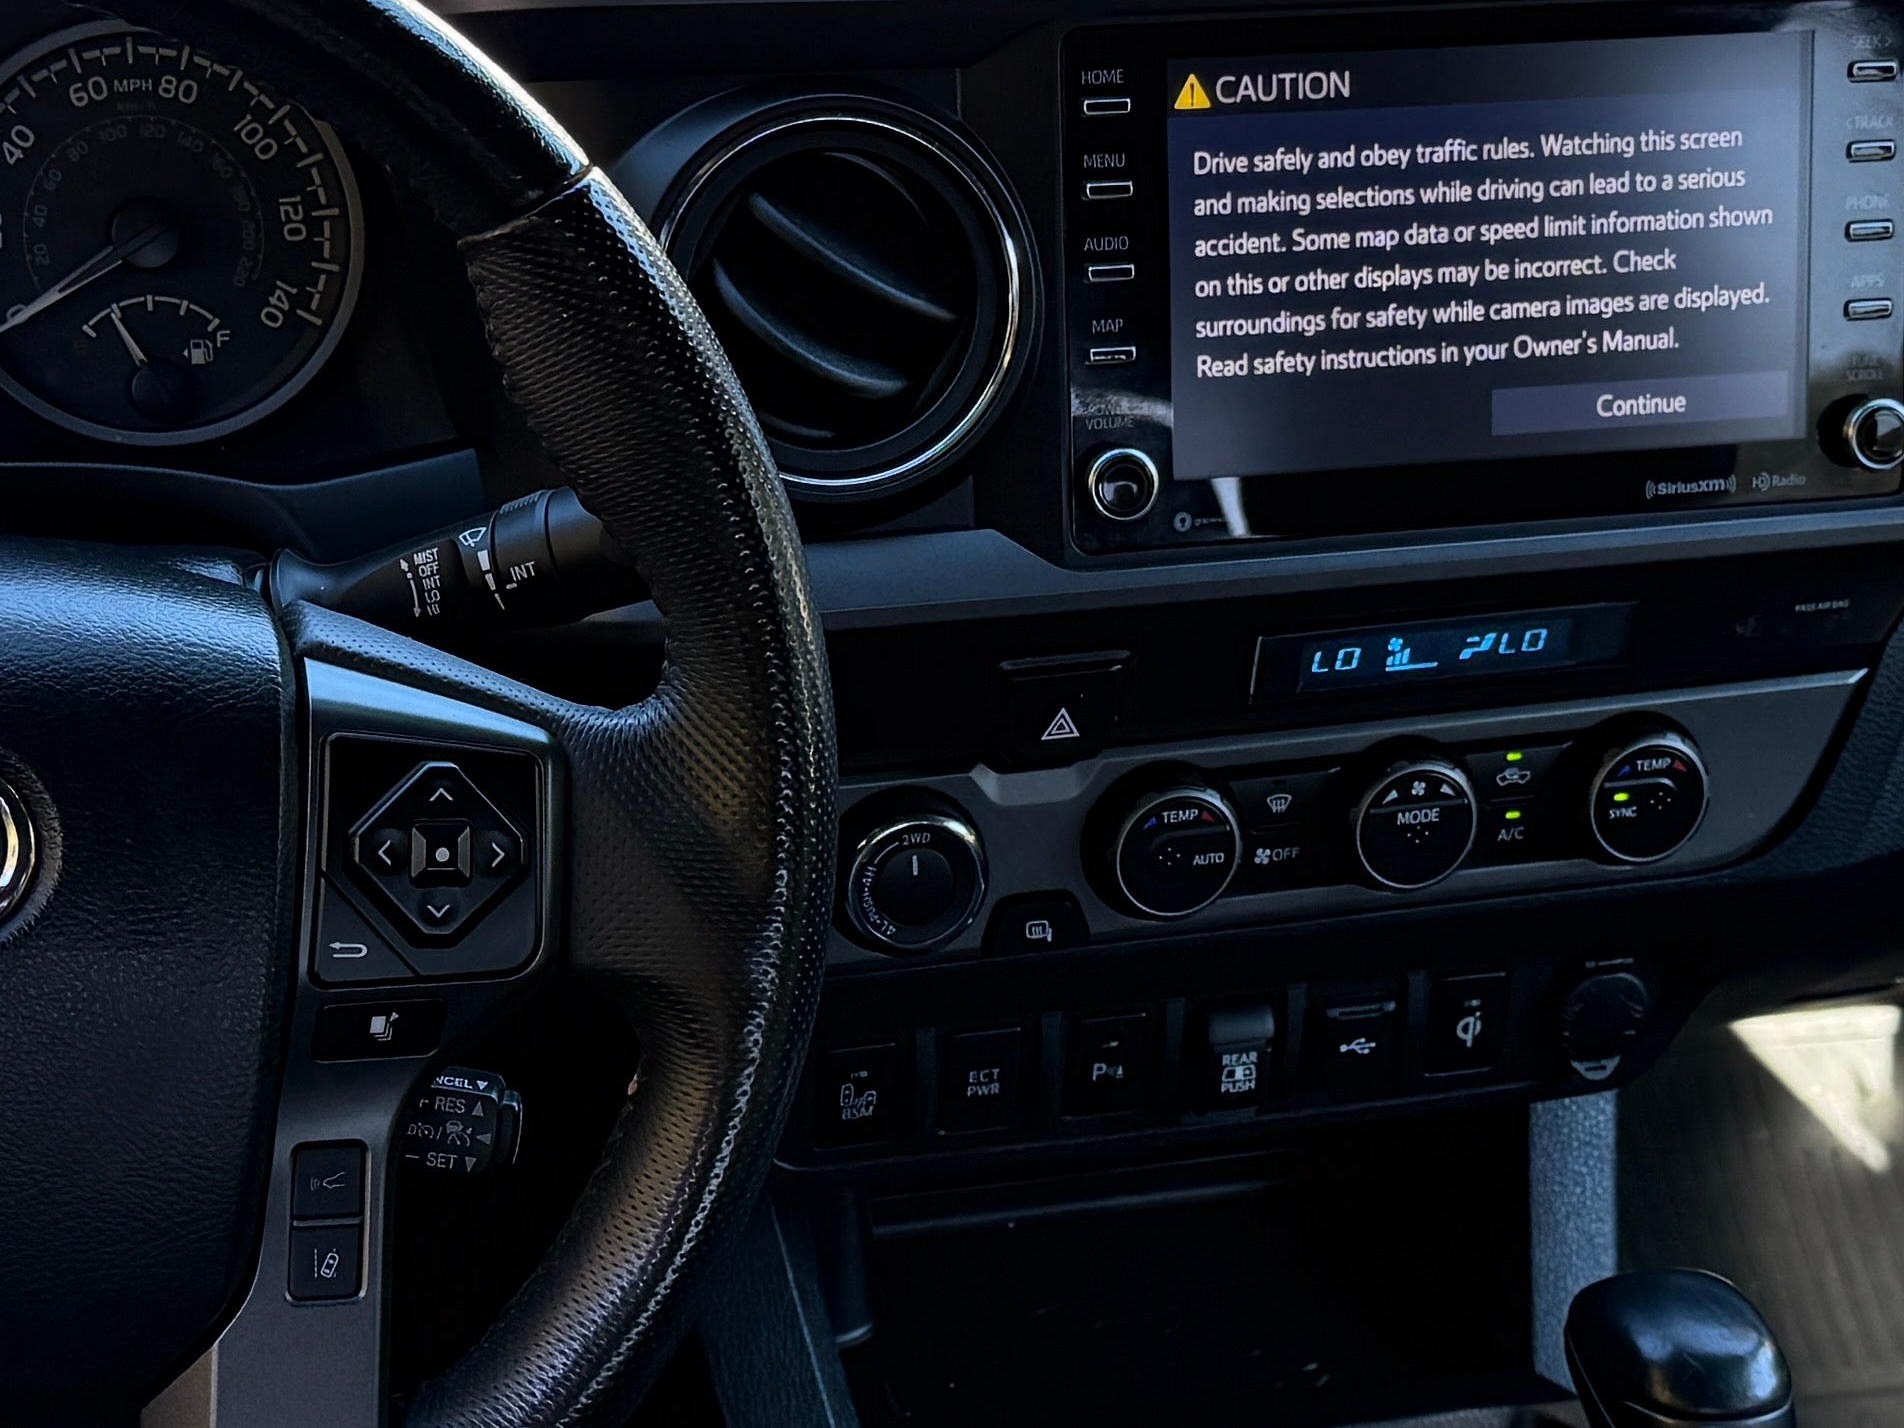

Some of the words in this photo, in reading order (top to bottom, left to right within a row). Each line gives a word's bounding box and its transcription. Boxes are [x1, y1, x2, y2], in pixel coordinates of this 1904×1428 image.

[1081, 69, 1125, 85] HOME
[68, 76, 109, 108] 60
[114, 79, 152, 93] MPH
[157, 75, 198, 104] 80
[1215, 71, 1350, 103] CAUTION
[1, 123, 35, 166] 40
[232, 114, 278, 161] 100
[1083, 152, 1125, 169] MENU
[1194, 152, 1248, 175] Drive
[1254, 147, 1313, 175] safely
[1318, 145, 1355, 168] and
[1361, 143, 1411, 170] obey
[1416, 139, 1478, 164] traffic
[1482, 137, 1535, 160] rules.
[1540, 132, 1634, 157] Watching
[1640, 129, 1675, 152] this
[1680, 129, 1742, 150] screen
[1194, 192, 1231, 216] and
[1238, 190, 1310, 215] making
[1316, 186, 1415, 210] selections
[1420, 180, 1472, 204] while
[1477, 179, 1544, 203] driving
[1549, 179, 1584, 197] can
[1590, 171, 1630, 195] lead
[1636, 173, 1656, 192] to
[1661, 174, 1673, 191] a
[1678, 168, 1745, 190] serious
[278, 196, 308, 242] 120
[1195, 233, 1286, 257] accident.
[1292, 228, 1350, 252] Some
[1356, 228, 1399, 251] map
[1404, 223, 1448, 246] data
[1454, 224, 1476, 242] or
[1480, 216, 1539, 245] speed
[1544, 215, 1586, 237] limit
[1591, 209, 1704, 234] information
[1709, 205, 1772, 228] shown
[1084, 236, 1129, 252] AUDIO
[1195, 279, 1222, 298] on
[1227, 273, 1263, 296] this
[1268, 276, 1289, 294] or
[1295, 268, 1348, 292] other
[1354, 264, 1433, 291] displays
[1438, 263, 1480, 286] may
[1485, 259, 1510, 281] be
[1515, 257, 1607, 279] incorrect.
[1613, 248, 1676, 273] Check
[260, 280, 298, 330] 140
[1196, 311, 1325, 338] surroundings
[1331, 307, 1361, 330] for
[1366, 304, 1427, 329] safety
[1433, 300, 1485, 324] while
[1489, 299, 1561, 321] camera
[1566, 294, 1634, 318] images
[1639, 292, 1669, 312] are
[1674, 282, 1769, 312] displayed.
[1092, 318, 1124, 334] MAP
[1197, 354, 1248, 378] Read
[1253, 350, 1315, 376] safety
[1321, 344, 1436, 371] instructions
[1441, 342, 1458, 364] in
[1464, 342, 1508, 367] your
[1513, 330, 1597, 359] Owner's
[1603, 327, 1679, 352] Manual.
[1597, 394, 1686, 417] Continue
[1085, 414, 1135, 430] VOLUME
[1772, 475, 1806, 487] Radio
[413, 548, 439, 565] MIST
[419, 563, 440, 577] OFF
[509, 561, 538, 583] INT
[422, 576, 441, 590] INT
[1499, 628, 1549, 655] LO
[1311, 647, 1362, 674] LO
[1636, 756, 1672, 774] TEMP
[1162, 808, 1199, 824] TEMP
[1397, 808, 1440, 826] MODE
[1609, 806, 1637, 820] SYNC
[902, 832, 931, 845] 2WD
[1497, 825, 1525, 843] A/C
[1192, 851, 1225, 867] AUTO
[1271, 846, 1301, 863] OFF
[1222, 1051, 1258, 1066] REAR
[969, 1068, 1000, 1083] ECT
[967, 1083, 1000, 1097] PWR
[1221, 1080, 1256, 1093] PUSH
[434, 1096, 466, 1113] RES
[426, 1153, 457, 1170] SET
